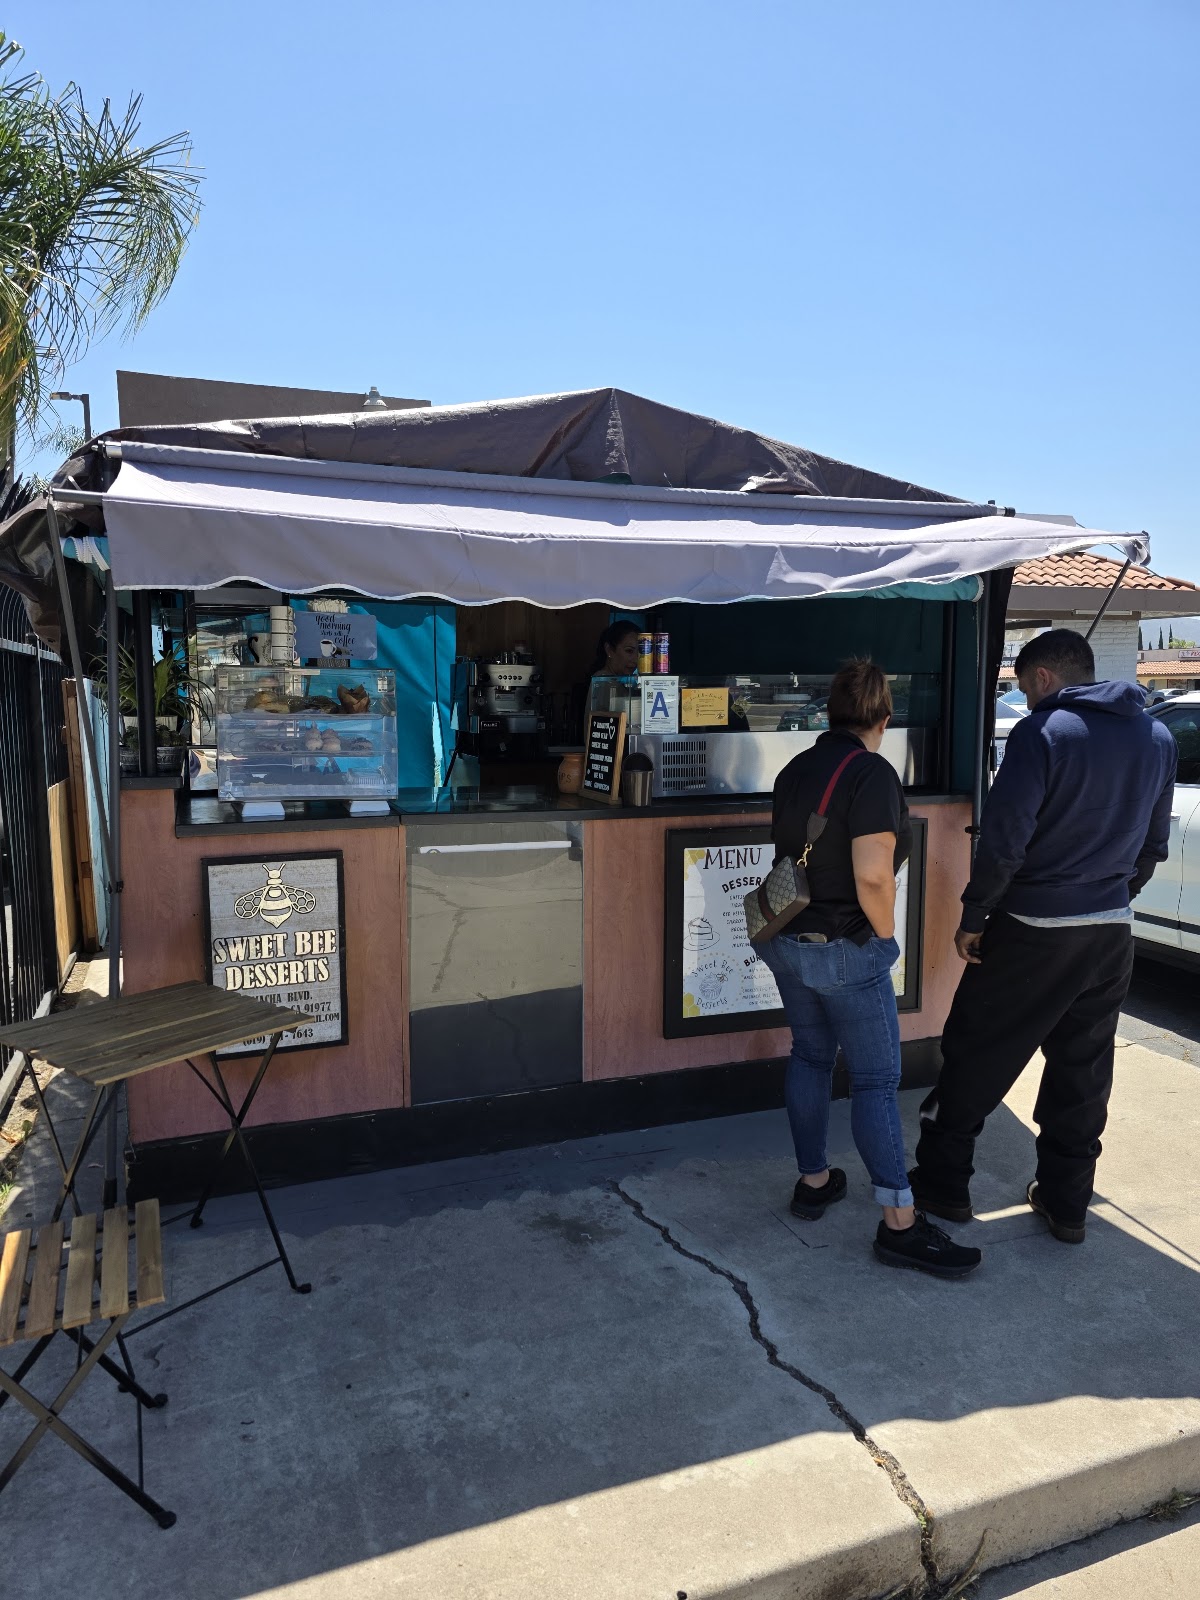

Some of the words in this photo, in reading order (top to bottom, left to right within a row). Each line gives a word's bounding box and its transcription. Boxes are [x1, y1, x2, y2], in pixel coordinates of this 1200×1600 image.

[315, 614, 335, 625] good
[320, 622, 351, 634] morning
[335, 635, 355, 647] coffee
[650, 691, 669, 718] A
[703, 847, 762, 870] MENU
[722, 876, 765, 893] DESSER
[213, 932, 288, 965] SWEET
[294, 929, 337, 957] BEE
[225, 957, 330, 991] DESSERTS
[256, 993, 282, 1004] ACHA
[287, 991, 313, 1002] BLVD.
[304, 1001, 332, 1013] 91977
[314, 1012, 340, 1023] IL.COM
